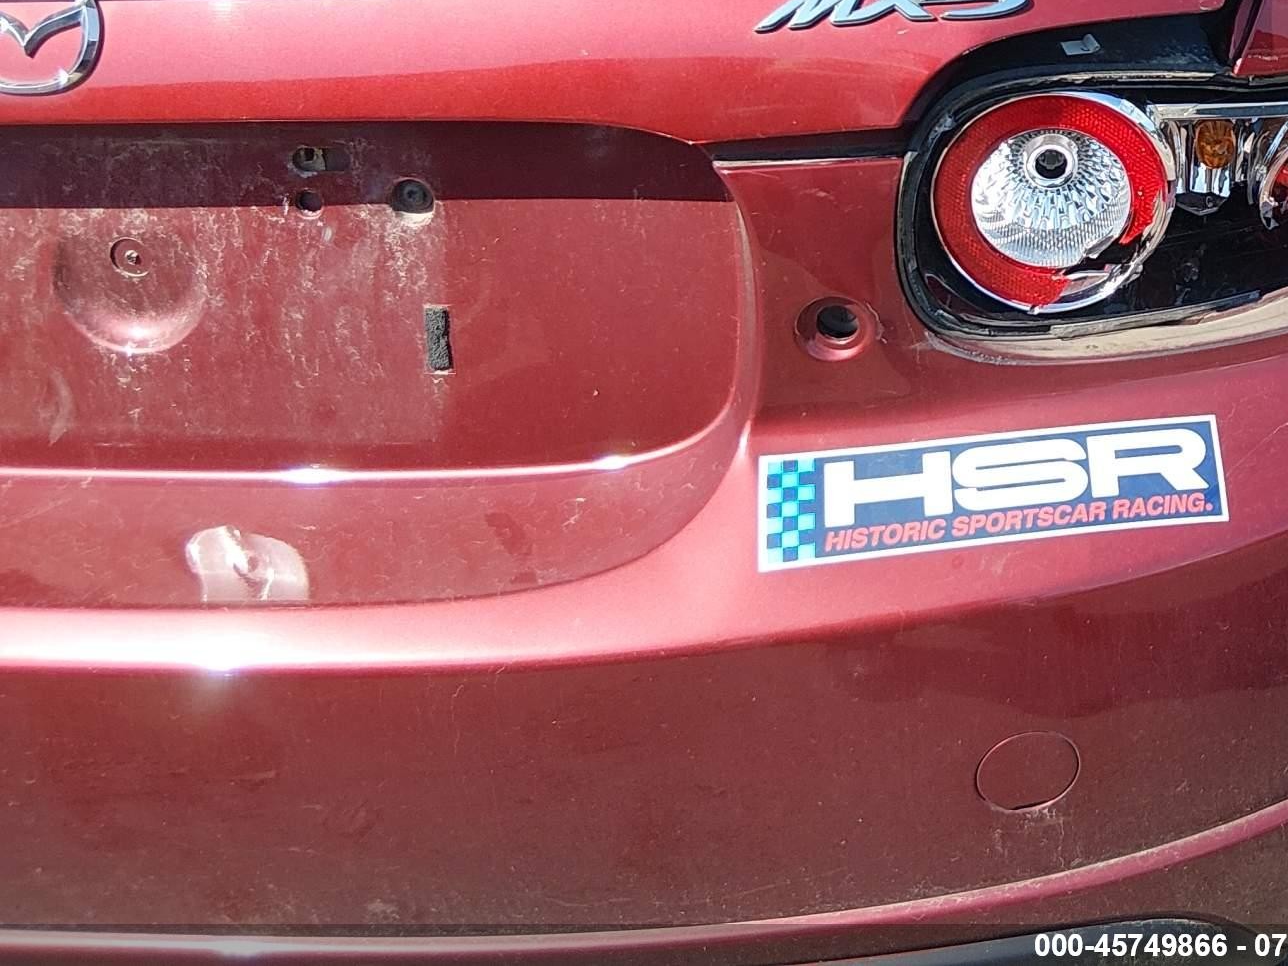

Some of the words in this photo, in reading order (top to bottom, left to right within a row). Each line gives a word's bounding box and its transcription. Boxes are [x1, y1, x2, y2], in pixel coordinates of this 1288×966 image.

[824, 429, 1209, 527] HSR
[825, 519, 947, 551] HISTORIC
[952, 501, 1107, 537] SPORTSCAR
